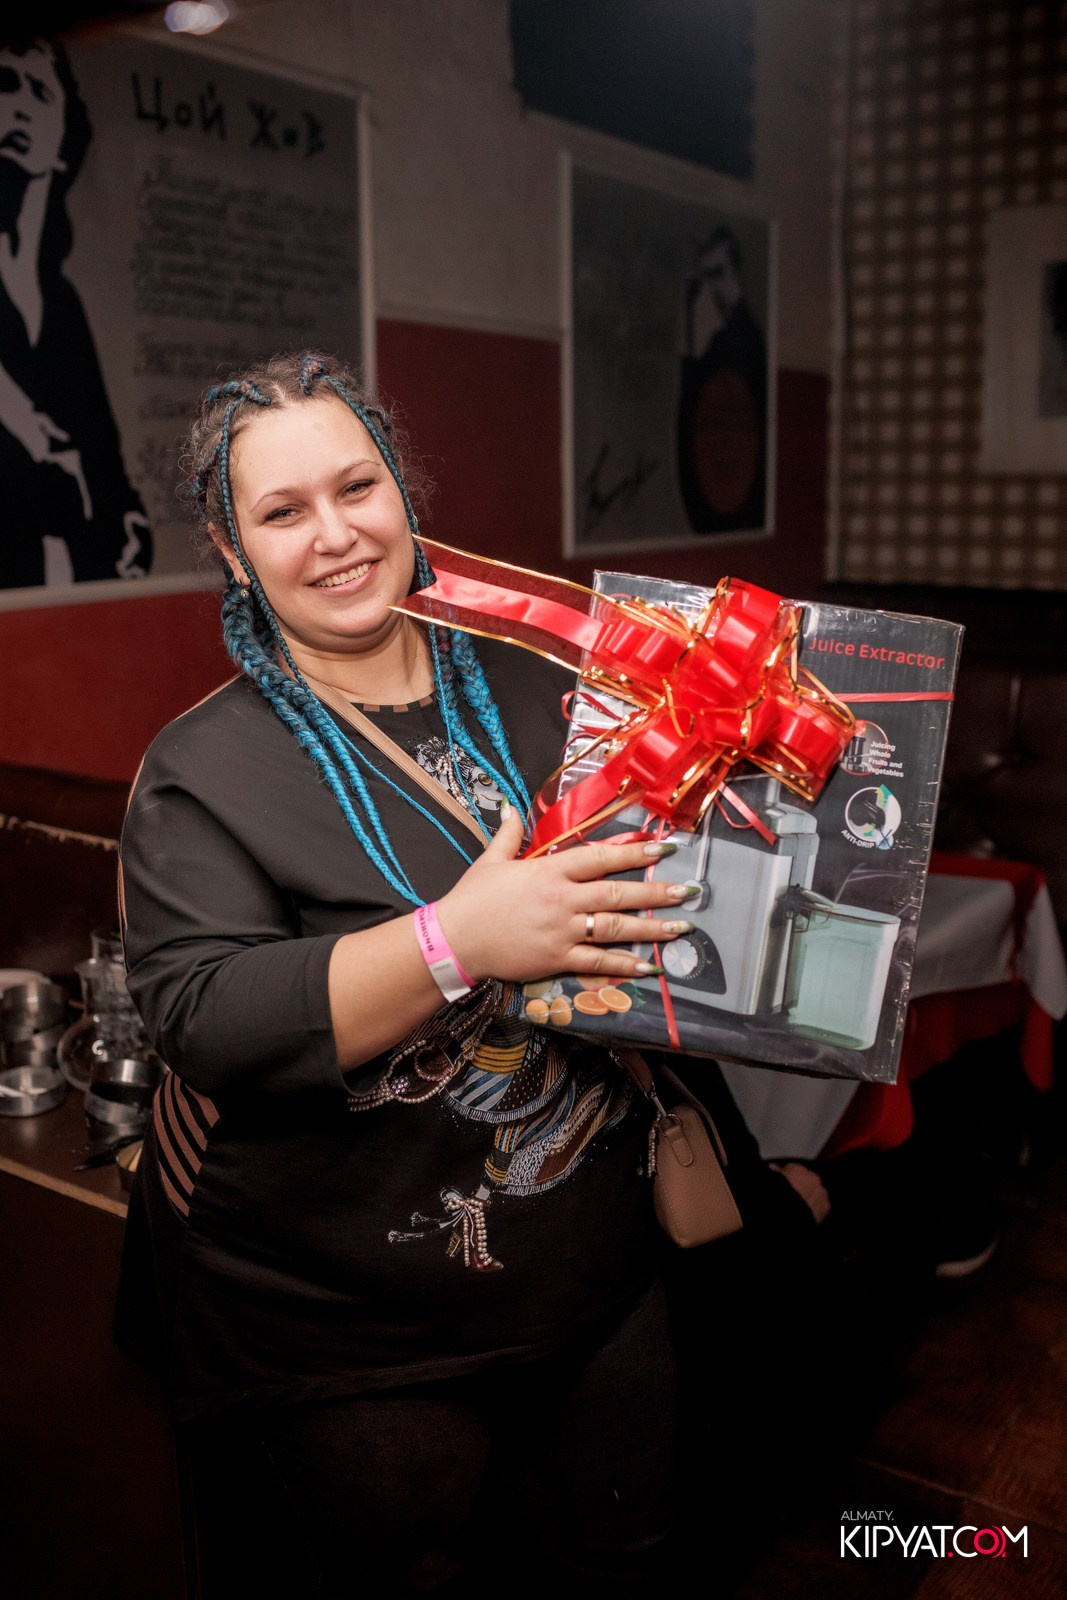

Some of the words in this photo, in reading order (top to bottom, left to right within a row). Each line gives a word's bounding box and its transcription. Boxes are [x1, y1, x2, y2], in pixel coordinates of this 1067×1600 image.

[131, 71, 227, 142] Цой
[808, 636, 855, 656] Juice
[859, 643, 945, 670] Extractor
[870, 741, 896, 752] Juicing
[870, 749, 891, 759] Whole
[868, 757, 888, 767] Fruits
[889, 761, 903, 769] and
[867, 767, 904, 778] Vegetables
[841, 829, 875, 849] ANTI-DRIP
